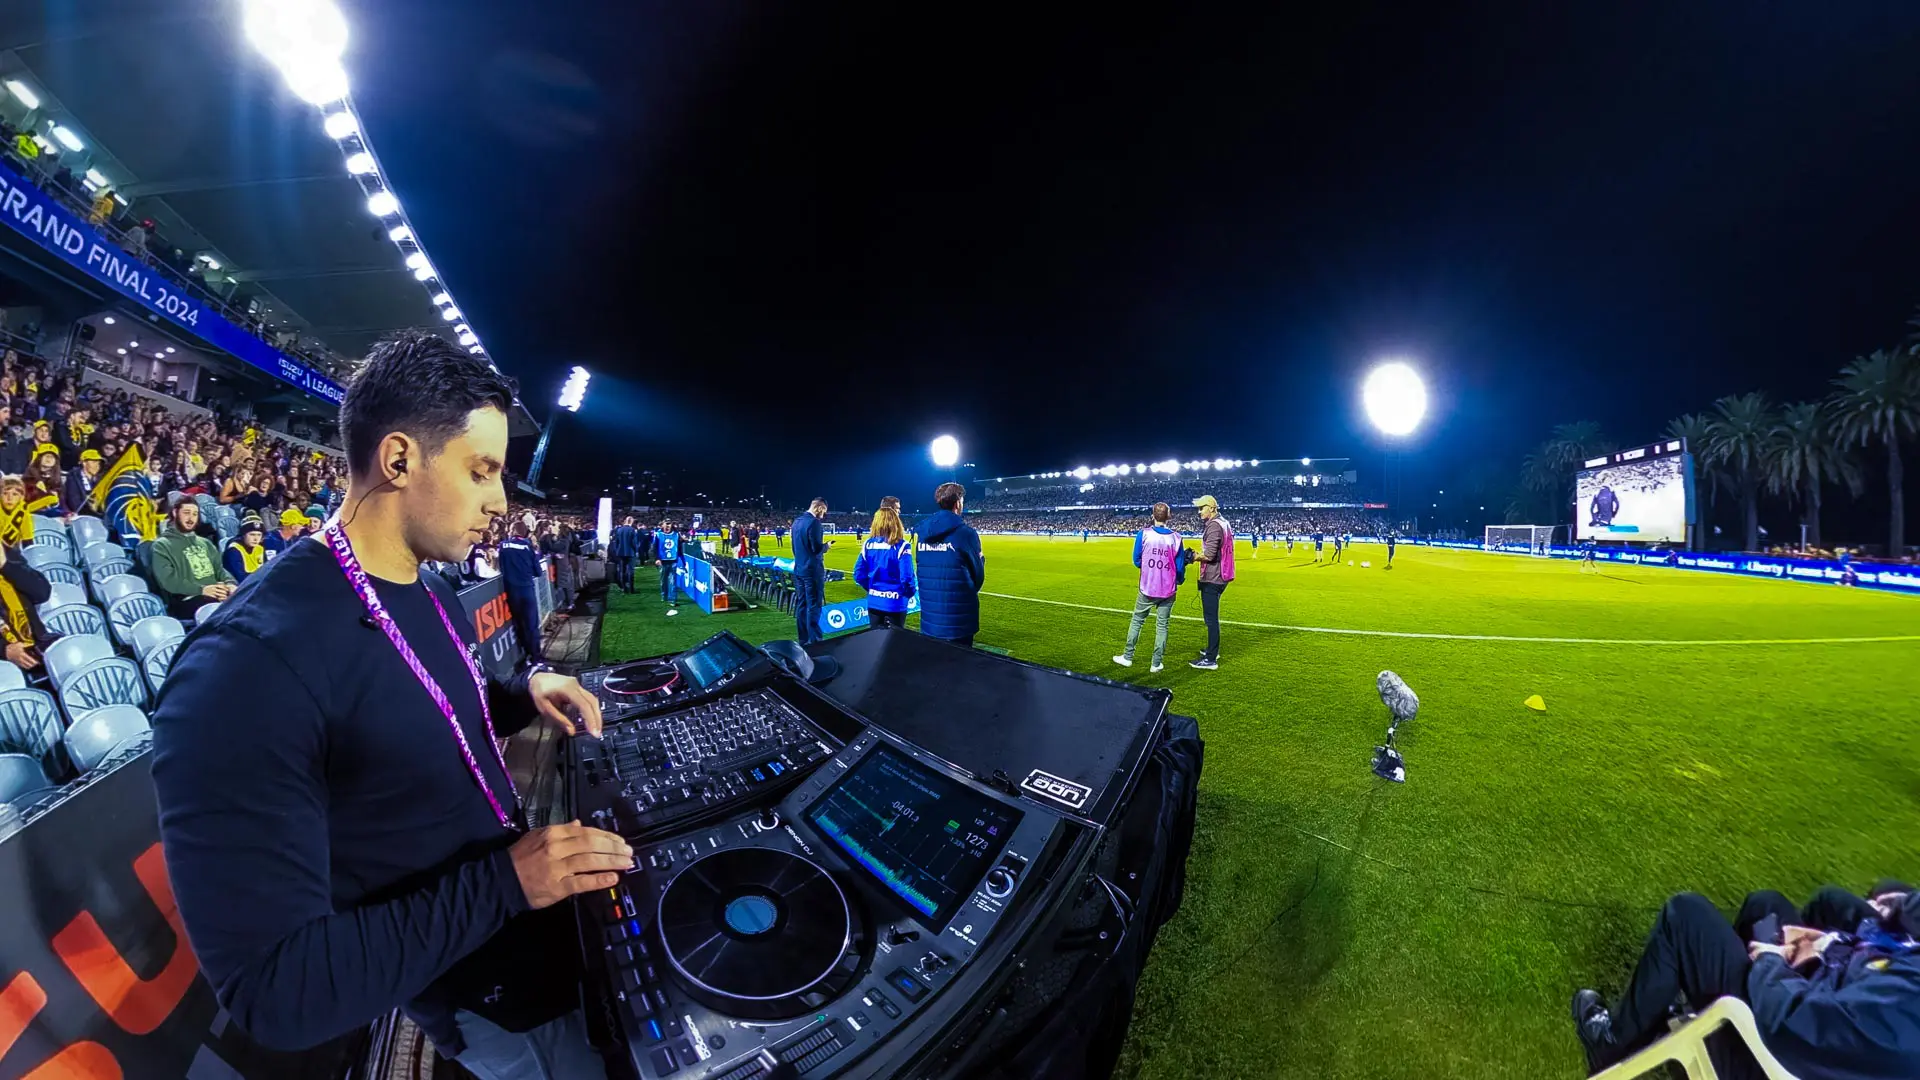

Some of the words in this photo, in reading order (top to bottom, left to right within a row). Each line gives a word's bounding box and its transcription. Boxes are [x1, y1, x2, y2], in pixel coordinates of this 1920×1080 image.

[86, 243, 151, 300] FINAL
[154, 287, 198, 326] 2024
[278, 357, 304, 376] ISUZU
[312, 377, 345, 403] LEAGUE
[1152, 547, 1169, 557] ENG
[1148, 558, 1171, 571] 004
[1033, 778, 1080, 801] UDG
[784, 824, 805, 847] DENON
